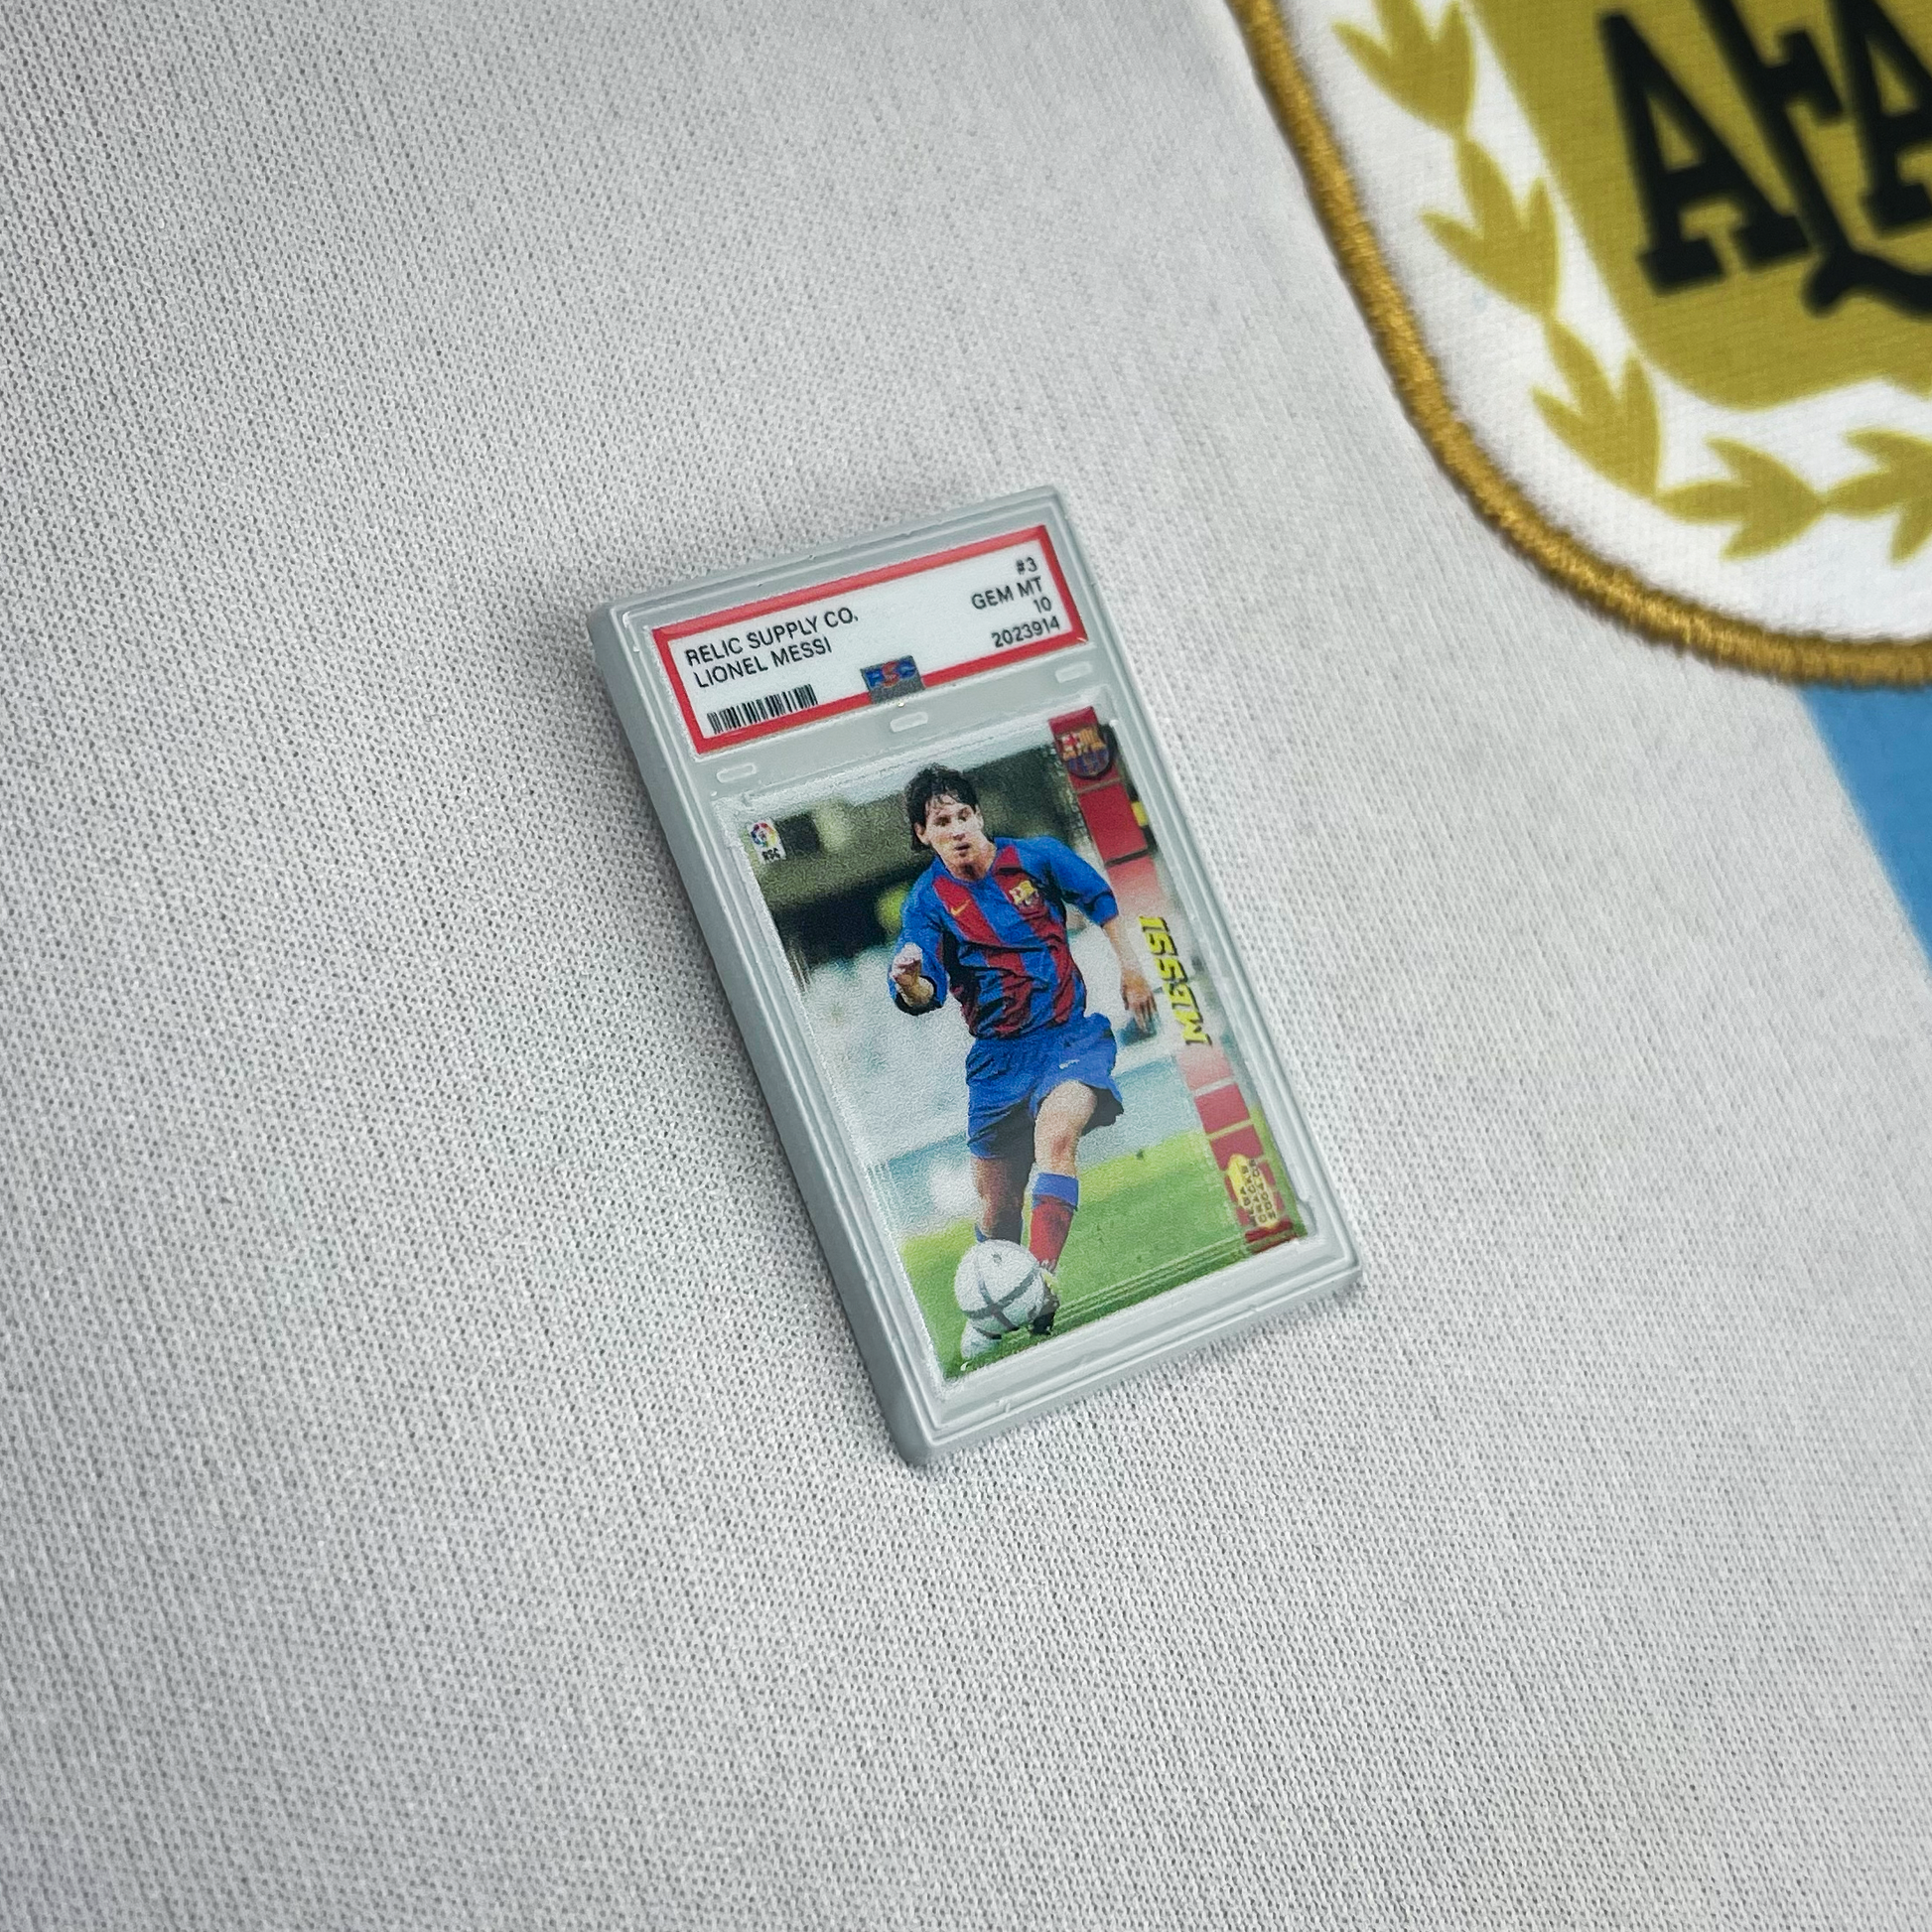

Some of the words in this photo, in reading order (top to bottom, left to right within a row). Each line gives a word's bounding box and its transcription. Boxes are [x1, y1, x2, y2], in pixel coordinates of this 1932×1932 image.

[1016, 557, 1037, 575] #3
[972, 585, 1014, 610] GEM
[1017, 576, 1042, 598] MT
[1034, 596, 1052, 614] 10
[685, 637, 743, 666] RELIC
[747, 616, 818, 648] SUPPLY
[991, 616, 1059, 648] 2023914
[693, 655, 768, 688] LIONEL
[770, 636, 832, 667] MESSI
[1139, 915, 1212, 1046] MESSI
